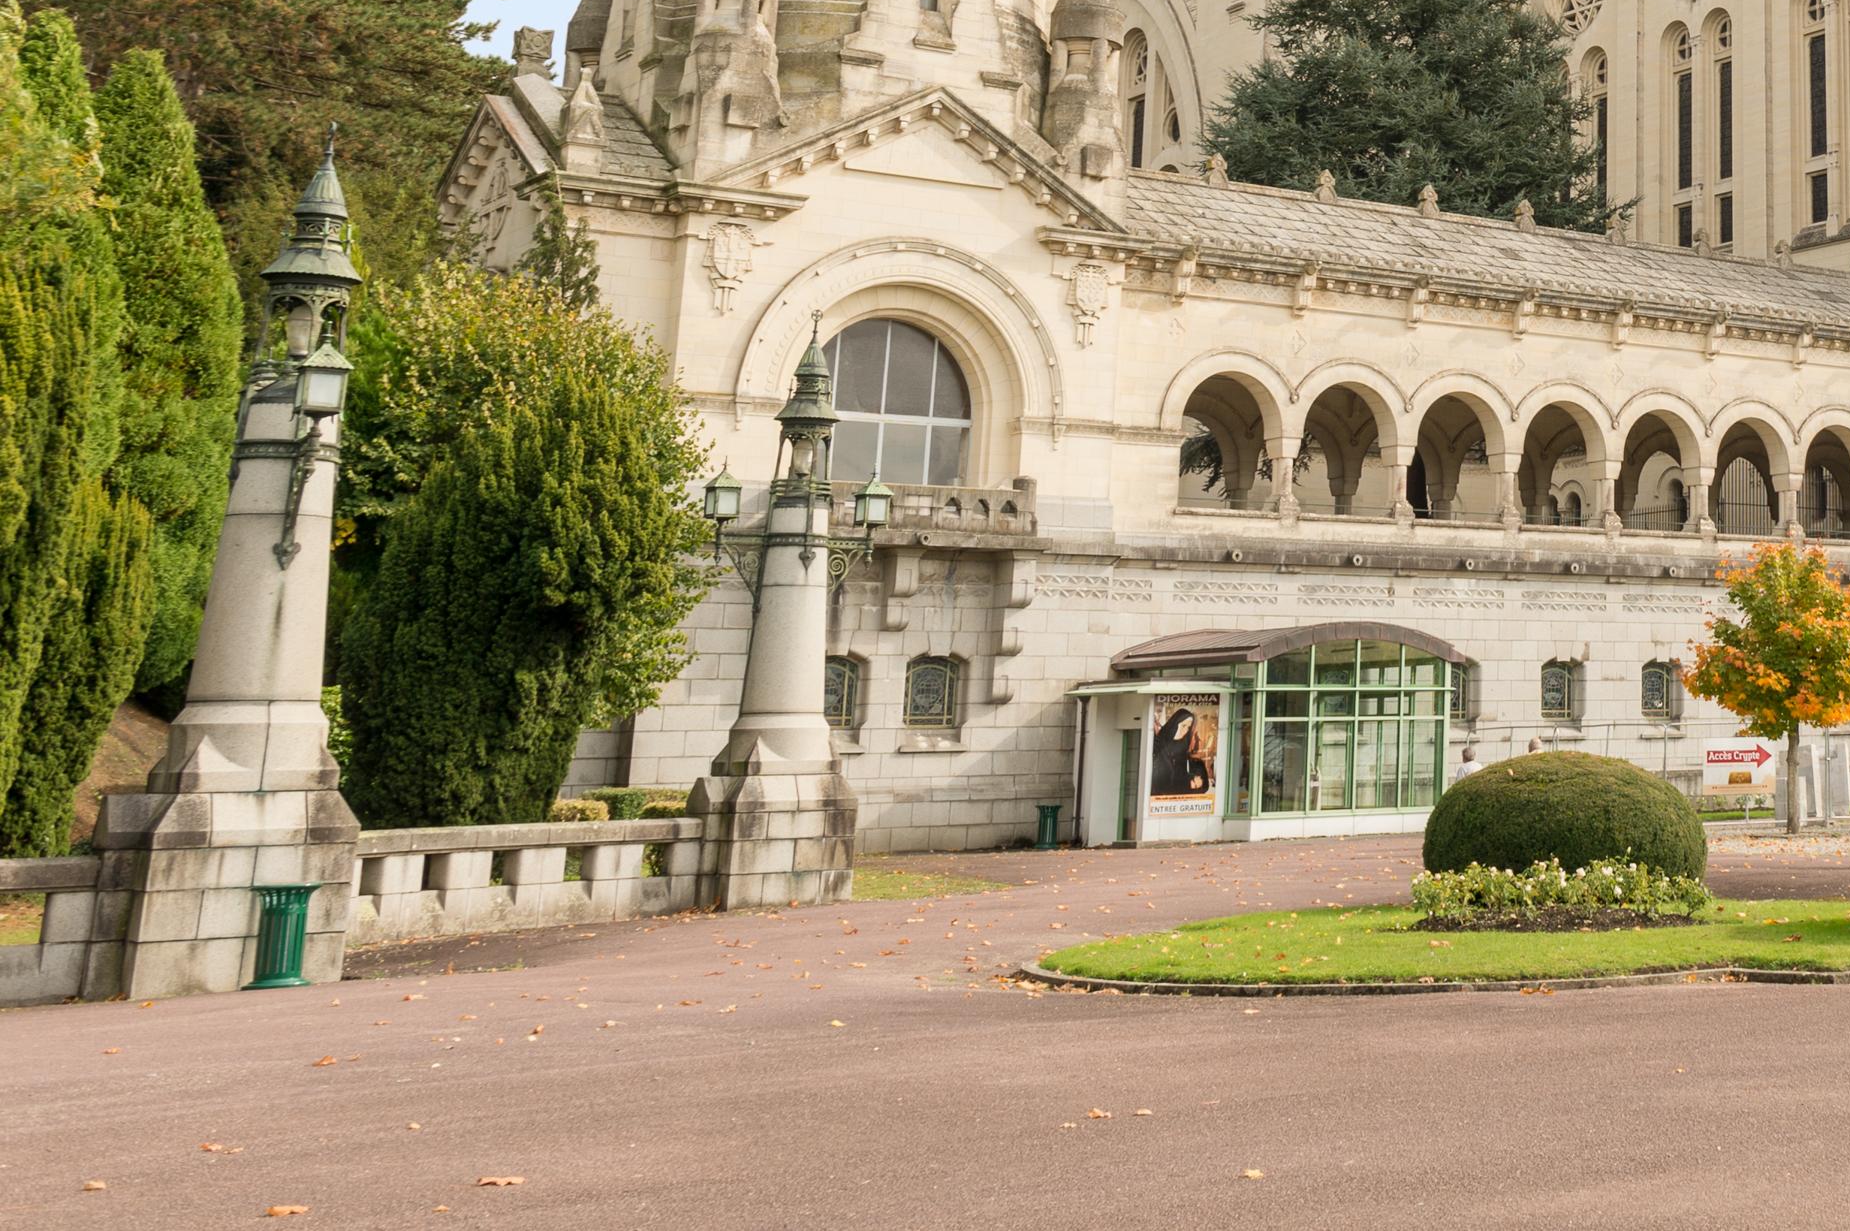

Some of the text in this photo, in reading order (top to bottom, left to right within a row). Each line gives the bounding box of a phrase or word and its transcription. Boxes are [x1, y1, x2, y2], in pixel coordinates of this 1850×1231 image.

[1157, 694, 1217, 702] DIORAMA
[1708, 751, 1760, 761] Accès Crypte
[1179, 803, 1211, 812] GRATUITE
